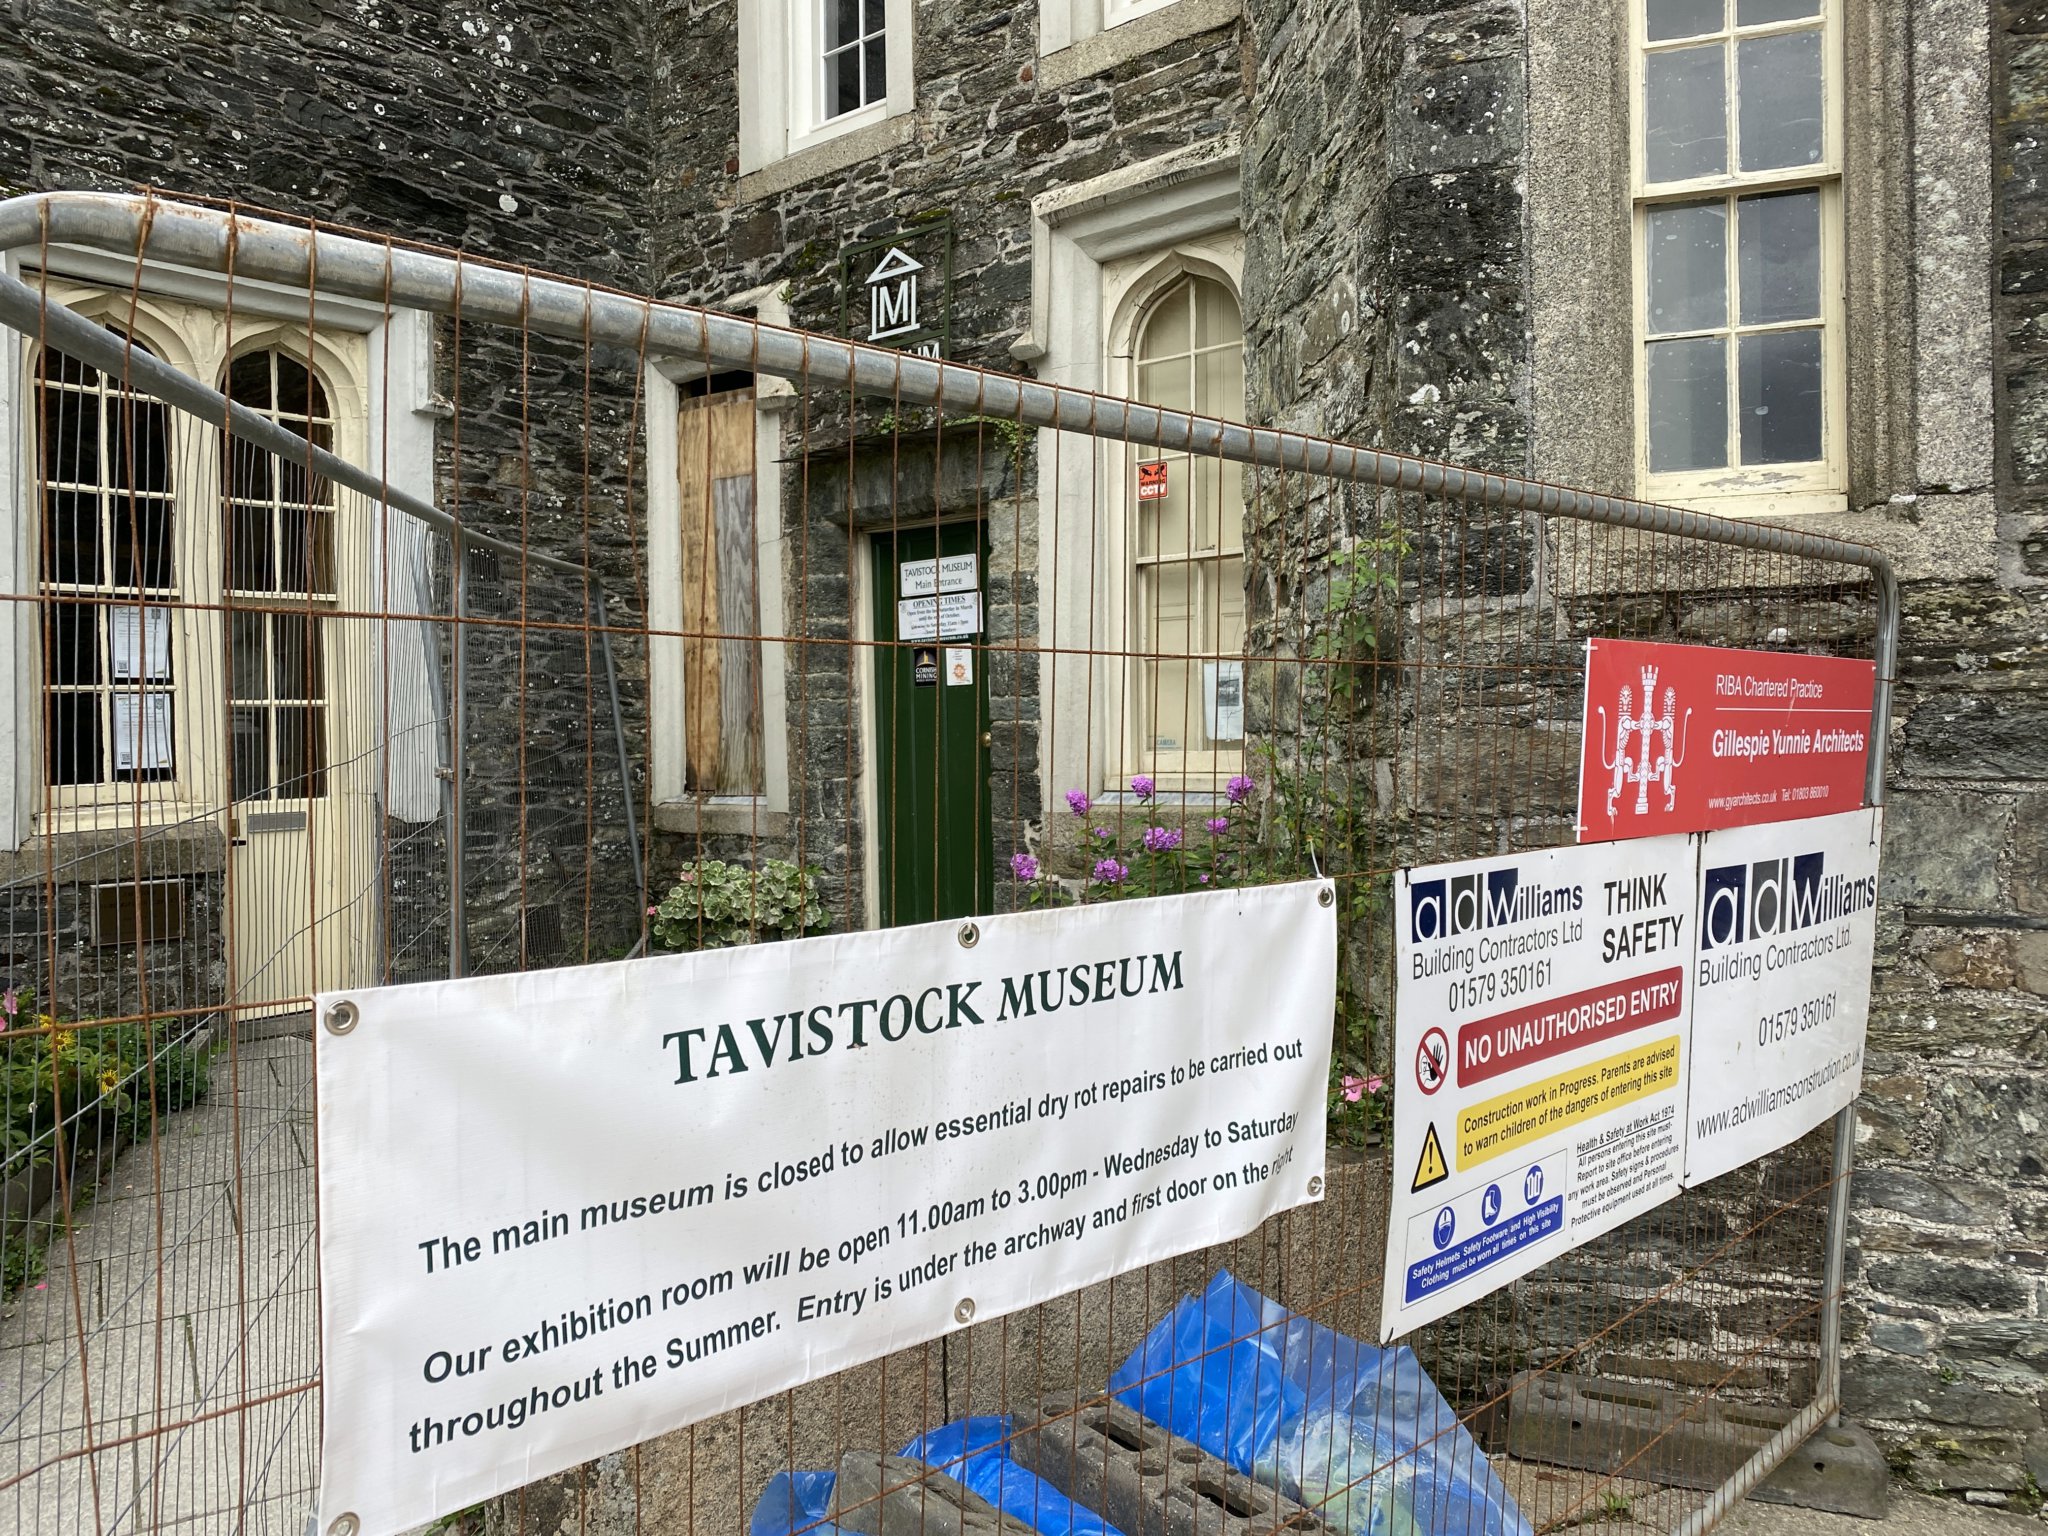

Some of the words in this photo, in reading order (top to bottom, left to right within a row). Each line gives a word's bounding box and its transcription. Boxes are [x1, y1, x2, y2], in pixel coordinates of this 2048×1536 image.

[1140, 484, 1166, 496] CCTV
[904, 564, 940, 578] TAVISTOC
[942, 561, 972, 573] MUSEUM
[916, 580, 932, 590] Main
[944, 596, 966, 605] TIMES
[1716, 674, 1742, 696] RIBA
[1744, 676, 1788, 697] Chartered
[1790, 678, 1823, 698] Practice
[1712, 729, 1770, 762] Gillespie
[1772, 729, 1810, 754] Yunnie
[1813, 729, 1864, 753] Architects
[1792, 786, 1809, 800] 01803
[1604, 873, 1667, 916] THINK
[1413, 947, 1474, 980] Building
[1479, 926, 1558, 964] Contractors
[1562, 918, 1582, 944] Ltd
[1602, 914, 1684, 964] SAFETY
[1700, 951, 1762, 987] Building
[1766, 933, 1833, 971] Contractors
[1836, 922, 1852, 950] Ltd.
[1449, 972, 1496, 1012] 01579
[1501, 958, 1552, 998] 350161
[662, 981, 984, 1085] TAVISTOCK
[996, 950, 1184, 1022] MUSEUM
[1465, 1034, 1492, 1069] NO
[1497, 995, 1626, 1057] UNAUTHORISED
[1631, 980, 1679, 1016] ENTRY
[1759, 1006, 1798, 1047] 01579
[1801, 991, 1837, 1032] 350161
[1464, 1102, 1523, 1134] Construction
[1526, 1090, 1547, 1110] work
[1549, 1087, 1557, 1101] in
[1559, 1075, 1598, 1097] Progress.
[1601, 1061, 1631, 1082] Parents
[1632, 1056, 1645, 1070] are
[1646, 1044, 1675, 1066] advised
[1464, 1142, 1473, 1156] to
[1476, 1134, 1498, 1152] warn
[1501, 1117, 1536, 1146] children
[1538, 1110, 1548, 1126] of
[1550, 1105, 1563, 1121] the
[1565, 1092, 1598, 1116] dangers
[1600, 1086, 1609, 1101] of
[1611, 1076, 1642, 1100] entering
[1644, 1068, 1658, 1086] this
[1659, 1065, 1672, 1081] site
[1697, 1046, 1861, 1140] www.adwilliamsconstruction.co.uk
[418, 1236, 482, 1274] The
[492, 1210, 569, 1254] main
[580, 1183, 714, 1230] museum
[724, 1174, 748, 1200] is
[758, 1144, 834, 1192] closed
[842, 1140, 864, 1167] to
[871, 1128, 929, 1159] allow
[935, 1098, 1032, 1141] essential
[1038, 1091, 1068, 1121] dry
[1073, 1083, 1098, 1110] rot
[1102, 1070, 1166, 1109] repairs
[1171, 1065, 1185, 1086] to
[1188, 1059, 1205, 1080] be
[1210, 1042, 1268, 1074] carried
[1274, 1038, 1303, 1061] out
[1577, 1136, 1598, 1154] Health
[1606, 1126, 1625, 1143] Safety
[1626, 1124, 1632, 1133] at
[1634, 1116, 1648, 1131] Work
[1650, 1111, 1660, 1123] Act
[1661, 1104, 1674, 1118] 1974
[1578, 1156, 1586, 1168] All
[1588, 1146, 1611, 1167] persons
[1613, 1136, 1635, 1154] entering
[1635, 1131, 1645, 1144] this
[1647, 1127, 1656, 1140] site
[1568, 1189, 1579, 1201] any
[1580, 1181, 1594, 1196] work
[1611, 1165, 1628, 1182] Safety
[1629, 1157, 1644, 1173] signs
[1650, 1144, 1679, 1168] procedures
[1577, 1165, 1597, 1182] Report
[1598, 1163, 1604, 1173] to
[1605, 1157, 1616, 1170] site
[1617, 1150, 1632, 1166] office
[1633, 1143, 1650, 1160] before
[1651, 1134, 1672, 1153] entering
[1582, 1193, 1597, 1208] must
[1598, 1190, 1605, 1201] be
[1606, 1176, 1632, 1197] observed
[1632, 1170, 1643, 1184] and
[1644, 1160, 1667, 1180] Personal
[1571, 1207, 1601, 1228] Protective
[1602, 1192, 1631, 1214] equipment
[1632, 1185, 1645, 1199] used
[1646, 1182, 1651, 1192] at
[424, 1344, 492, 1384] Our
[502, 1293, 652, 1363] exhibition
[662, 1268, 733, 1311] room
[743, 1252, 790, 1285] will
[799, 1247, 830, 1273] be
[838, 1224, 890, 1262] open
[896, 1198, 985, 1238] 11.00am
[991, 1188, 1011, 1211] to
[1018, 1167, 1087, 1206] 3.00pm
[1104, 1133, 1199, 1178] Wednesday
[1204, 1127, 1222, 1149] to
[1227, 1110, 1299, 1142] Saturday
[1412, 1263, 1434, 1280] Safety
[1435, 1252, 1460, 1271] Helmets
[1463, 1240, 1481, 1256] Safety
[1482, 1227, 1508, 1247] Footware
[1510, 1219, 1520, 1233] and
[1523, 1211, 1536, 1227] High
[1537, 1203, 1559, 1220] Visibility
[1421, 1269, 1449, 1288] Clothing
[1452, 1261, 1468, 1276] must
[1469, 1256, 1476, 1267] be
[1477, 1250, 1491, 1263] worn
[1492, 1244, 1500, 1255] all
[1501, 1236, 1517, 1250] times
[1519, 1232, 1527, 1241] on
[1528, 1225, 1539, 1236] this
[1541, 1219, 1551, 1230] site
[409, 1368, 603, 1453] throughout
[612, 1351, 658, 1389] the
[666, 1308, 781, 1369] Summer.
[797, 1288, 867, 1322] Entry
[874, 1275, 892, 1302] is
[898, 1251, 957, 1292] under
[964, 1239, 997, 1265] the
[1004, 1213, 1086, 1256] archway
[1092, 1203, 1127, 1230] and
[1132, 1190, 1162, 1217] first
[1166, 1176, 1207, 1204] door
[1213, 1170, 1237, 1192] on
[1242, 1160, 1269, 1184] the
[1271, 1144, 1293, 1176] right
